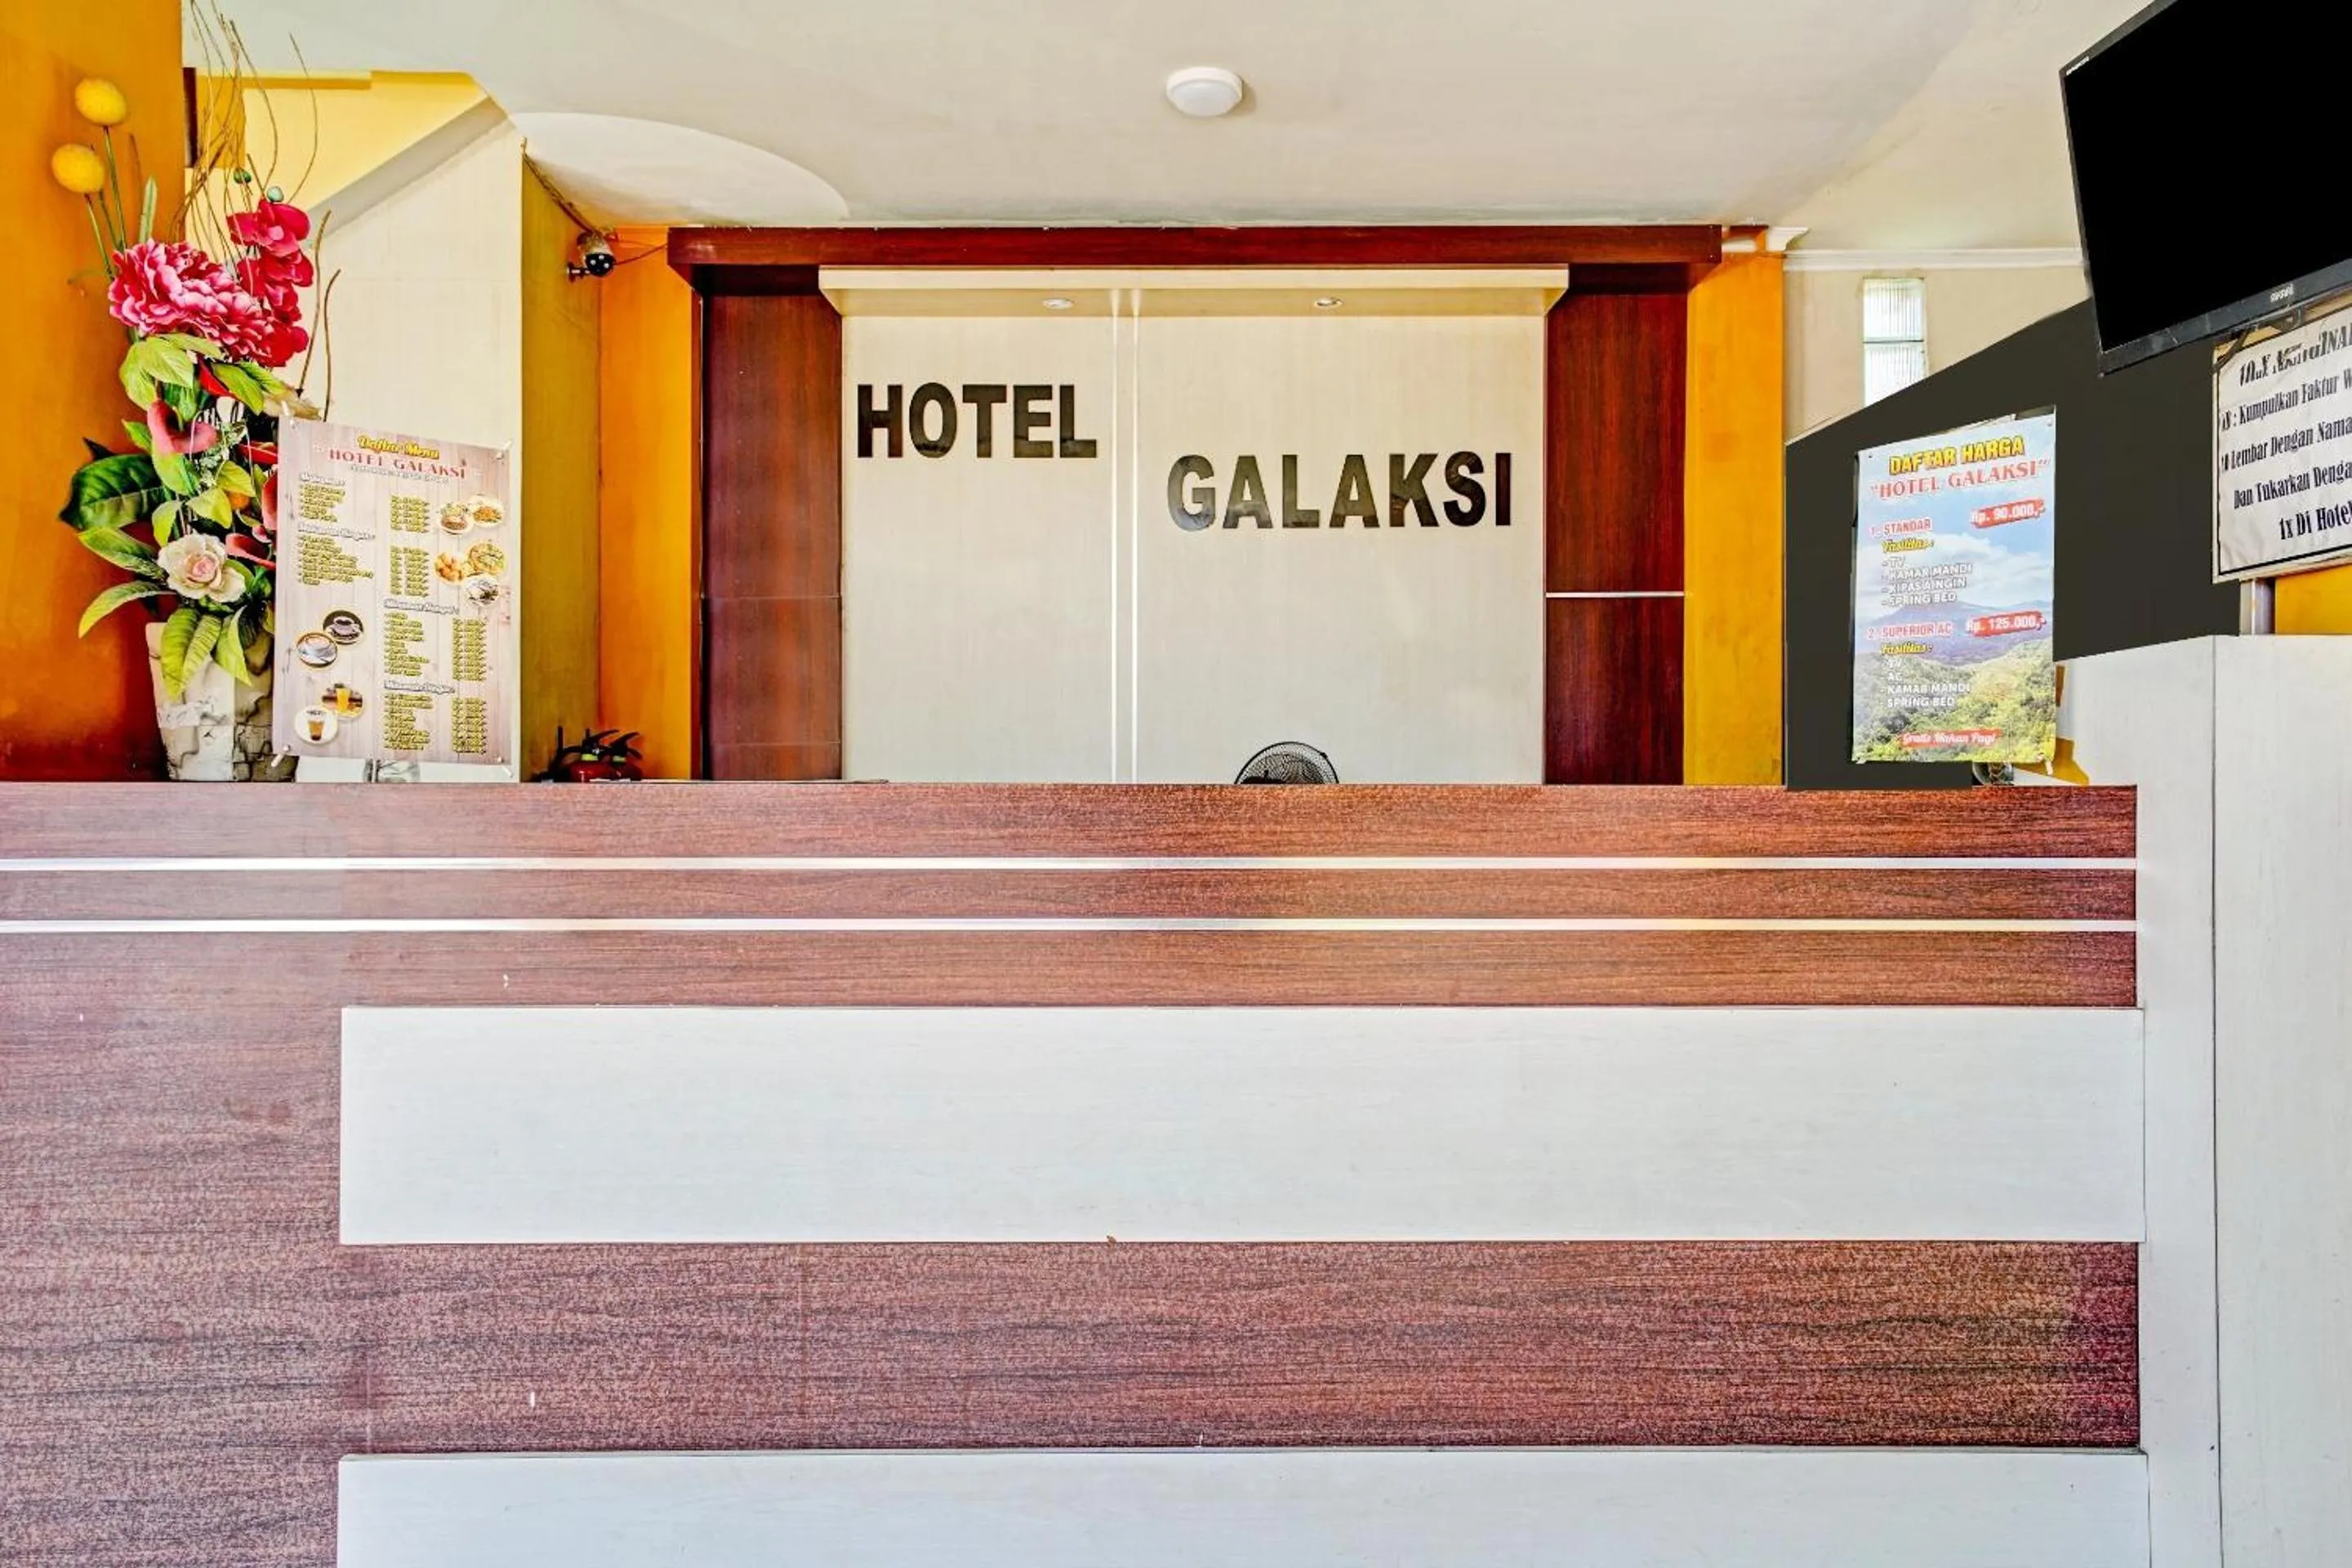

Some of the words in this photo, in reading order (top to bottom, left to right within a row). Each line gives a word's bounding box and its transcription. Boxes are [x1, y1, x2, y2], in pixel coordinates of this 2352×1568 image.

[2239, 389, 2298, 424] Kumpulkan
[2301, 376, 2339, 403] Faktur
[857, 382, 1097, 459] HOTEL
[358, 435, 402, 453] Daftar
[404, 441, 439, 459] Menu
[1889, 447, 1957, 475] DAFTAR
[1960, 435, 2025, 465] HARGA
[2231, 442, 2268, 470] Lembar
[2270, 429, 2314, 457] Dengan
[329, 449, 382, 466] HOTEL
[394, 459, 466, 479] GALAKSI
[1168, 451, 1512, 532] GALAKSI
[2234, 489, 2253, 510] Dan
[2256, 471, 2310, 502] Tukarkan
[1884, 519, 1931, 534] STANDAR
[2279, 518, 2293, 540] 1x
[2296, 510, 2312, 536] Di
[1931, 562, 1973, 577] MANDI
[1888, 593, 1931, 607] SPRING
[1933, 591, 1957, 604] BED
[1882, 624, 1934, 638] SUPERIOR
[1936, 621, 1953, 635] AC
[1887, 697, 1931, 708] SPRING
[1933, 697, 1956, 707] BED
[1931, 683, 1971, 693] MANDI
